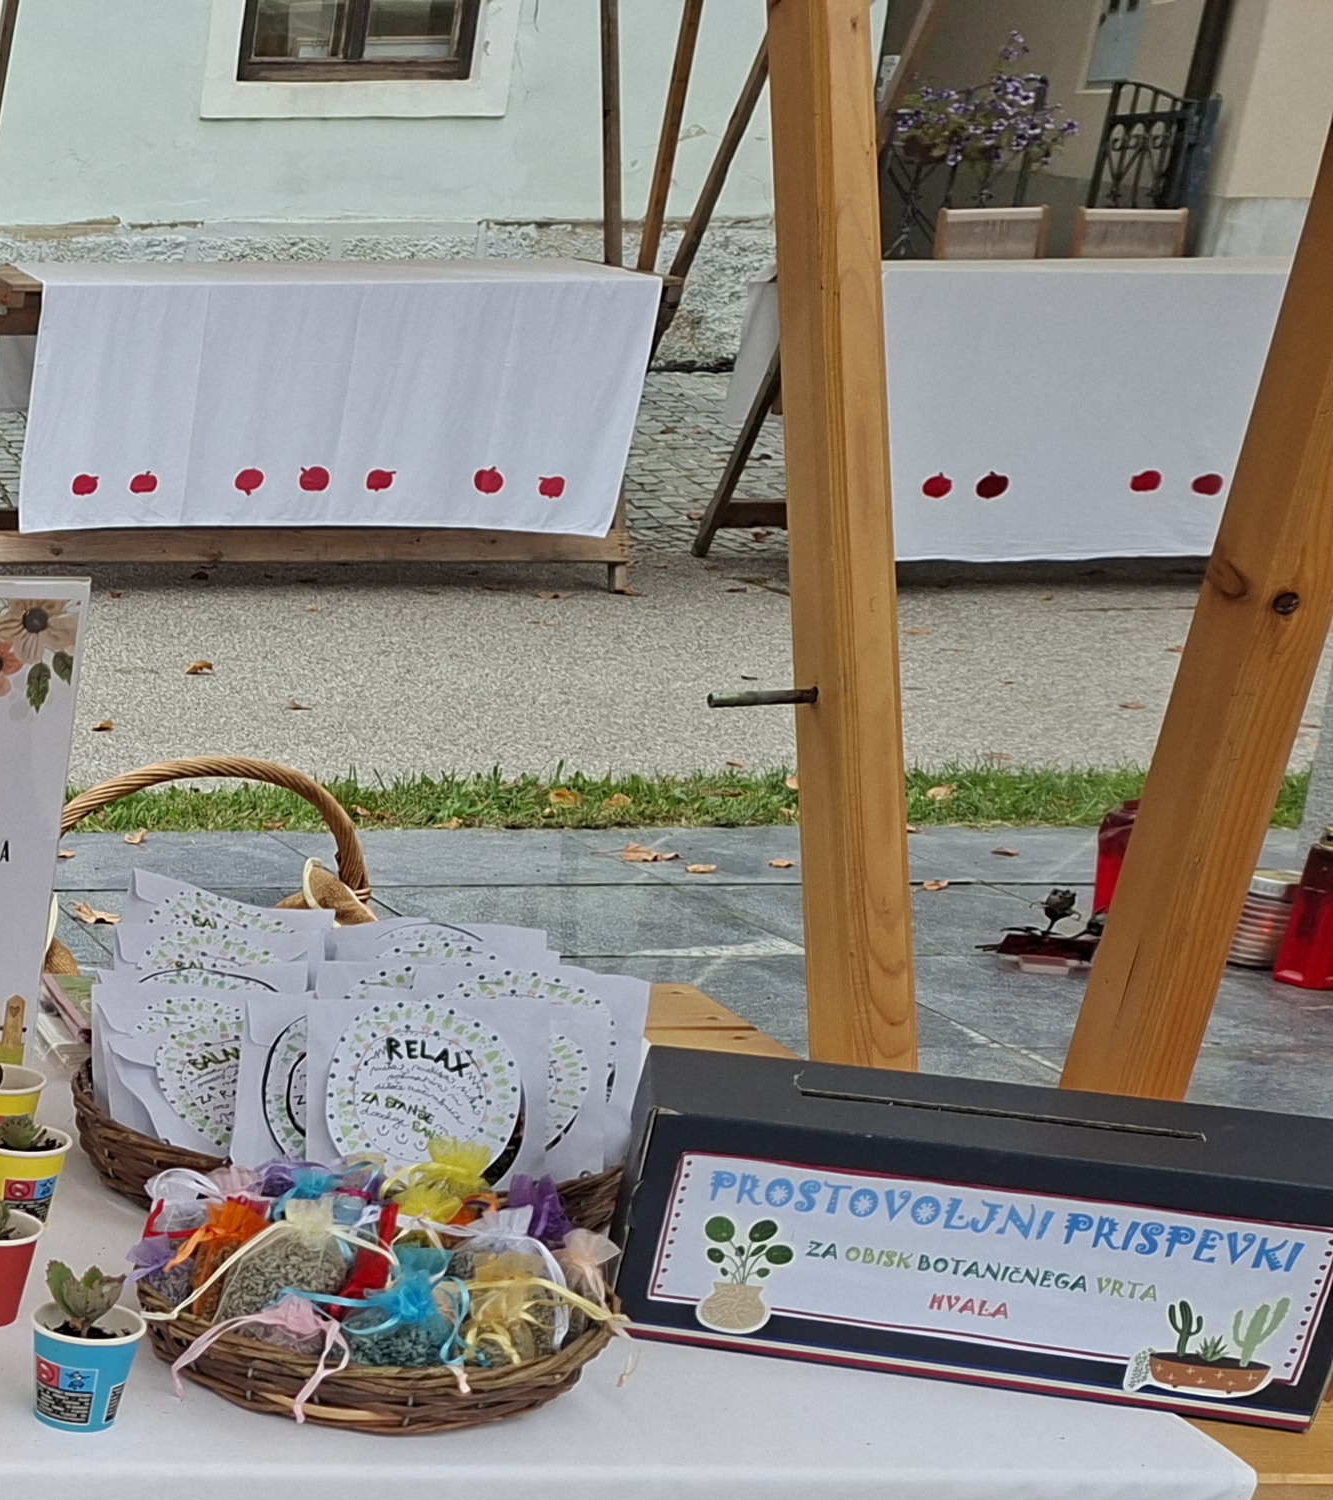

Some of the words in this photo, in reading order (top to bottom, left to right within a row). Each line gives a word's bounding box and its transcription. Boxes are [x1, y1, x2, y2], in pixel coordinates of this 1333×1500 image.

[386, 1037, 471, 1077] RELAX
[710, 1169, 1055, 1241] PROSTOVOLJNI
[1064, 1212, 1304, 1272] PRISPEVKI
[806, 1240, 838, 1260] ZA
[845, 1246, 911, 1269] OBISK
[918, 1254, 1088, 1293] BOTANIČNEGA
[1097, 1277, 1159, 1303] VRTA
[930, 1293, 1010, 1320] HVALA
